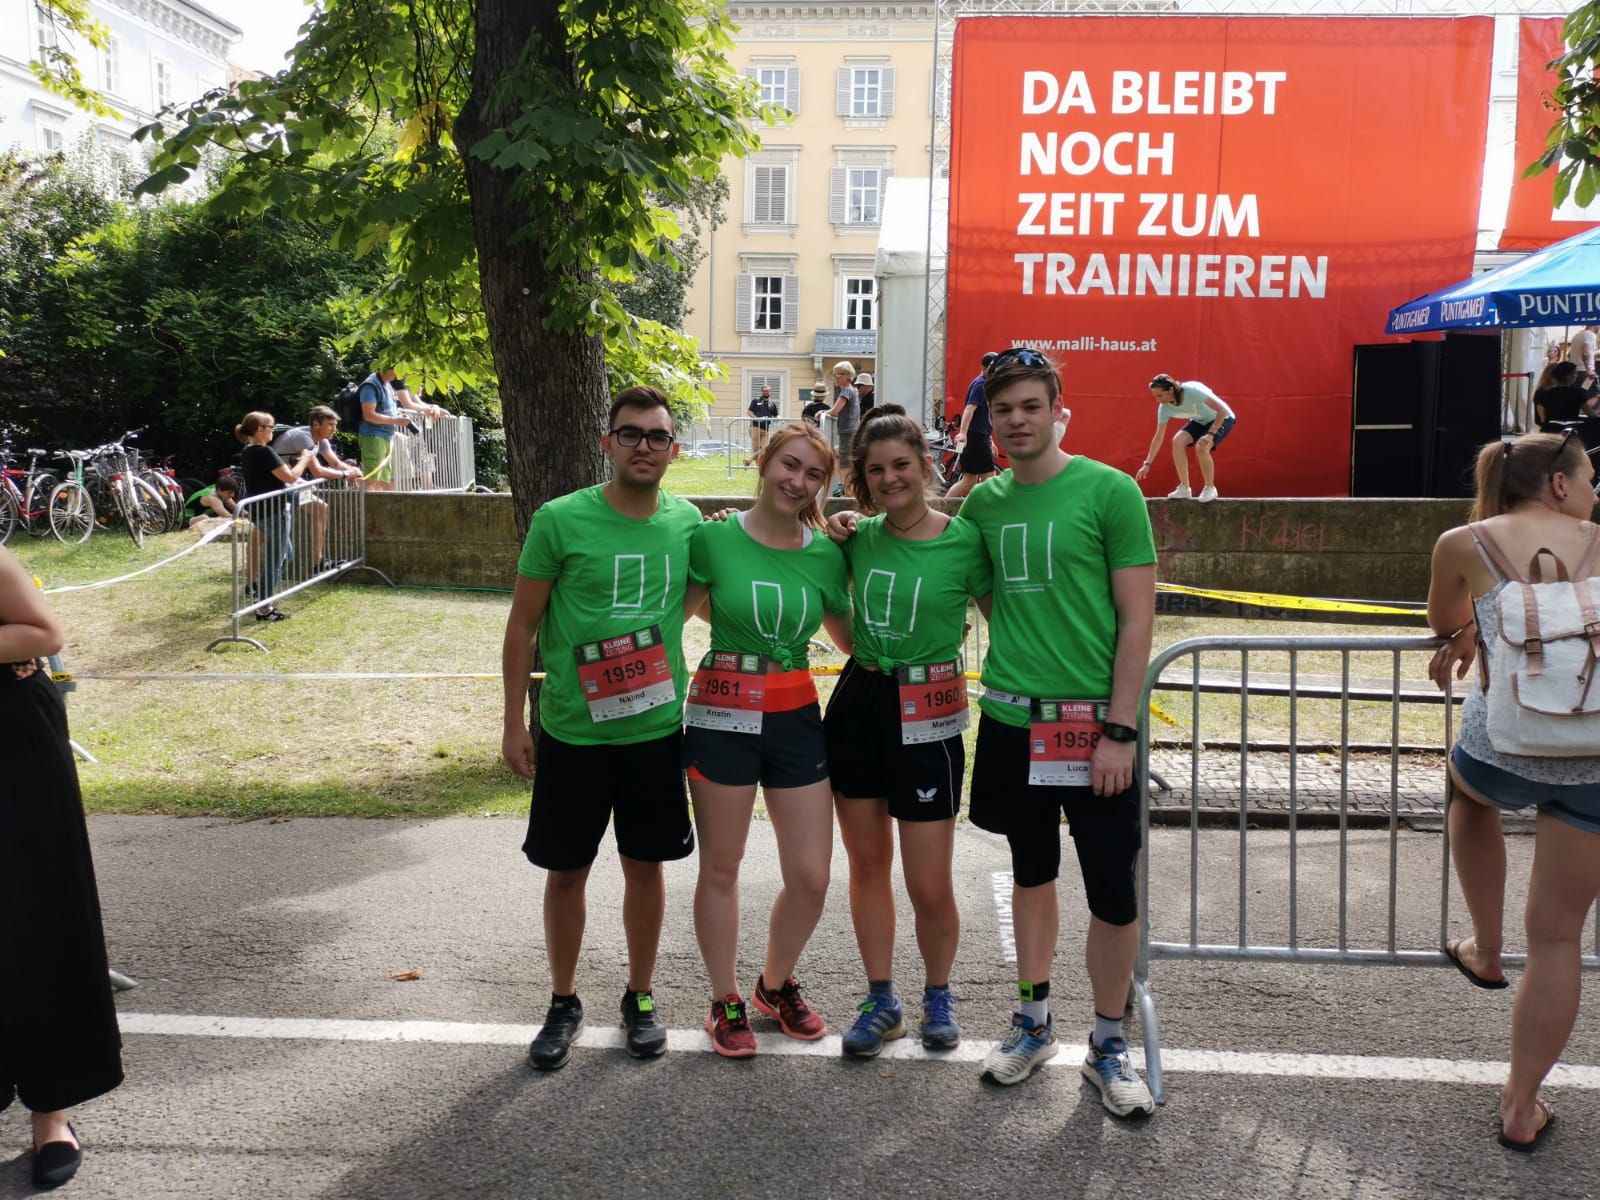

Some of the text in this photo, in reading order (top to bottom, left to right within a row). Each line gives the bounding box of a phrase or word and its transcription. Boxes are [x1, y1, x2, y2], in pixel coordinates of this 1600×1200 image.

[1022, 71, 1287, 115] DA BLEIBT
[1020, 131, 1175, 176] NOCH
[1017, 192, 1260, 238] ZEIT ZUM
[1014, 252, 1329, 299] TRAINIEREN
[1440, 296, 1485, 323] PUNTIGAMER
[1520, 292, 1600, 316] PUNTI
[1391, 306, 1431, 331] PUNTIGAMER
[1011, 336, 1158, 352] www.malli-haus.at
[603, 637, 631, 650] KLEINE
[602, 659, 647, 684] 1959
[930, 663, 955, 674] KLEINE
[705, 678, 740, 697] 1961
[923, 686, 959, 708] 1960
[1061, 705, 1092, 713] KLEINE
[1053, 730, 1101, 749] 1958
[1067, 763, 1089, 773] Luca
